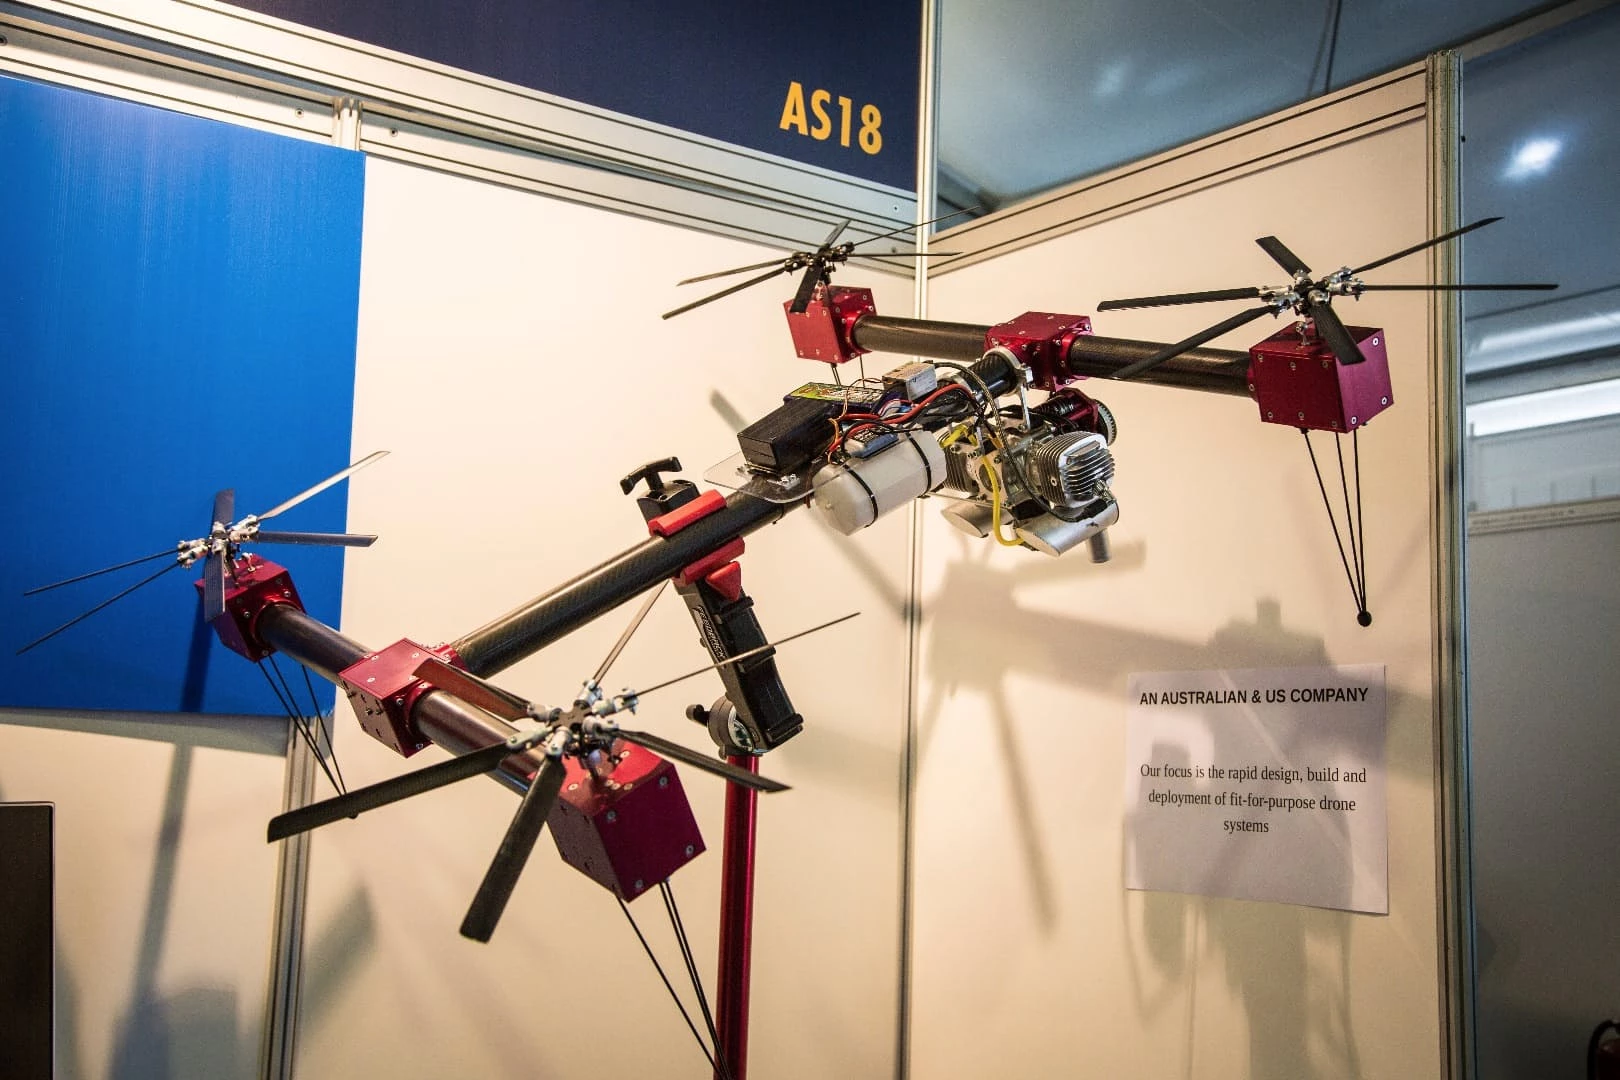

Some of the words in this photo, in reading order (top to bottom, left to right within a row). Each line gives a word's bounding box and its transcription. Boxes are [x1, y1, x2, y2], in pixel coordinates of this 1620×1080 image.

[779, 81, 882, 155] AS18
[1140, 692, 1157, 705] AN
[1161, 690, 1247, 704] AUSTRALIAN
[1251, 689, 1261, 703] &
[1266, 689, 1286, 703] US
[1290, 687, 1368, 703] COMPANY
[1140, 764, 1161, 777] Our
[1164, 764, 1192, 777] focus
[1196, 765, 1205, 778] is
[1208, 764, 1225, 779] the
[1228, 766, 1257, 783] rapid
[1261, 766, 1303, 784] design,
[1307, 767, 1339, 782] build
[1343, 768, 1367, 782] and
[1148, 789, 1211, 807] deployment
[1215, 792, 1226, 806] of
[1230, 792, 1316, 812] fit-for-purpose
[1319, 795, 1356, 811] drone
[1223, 819, 1269, 834] systems
